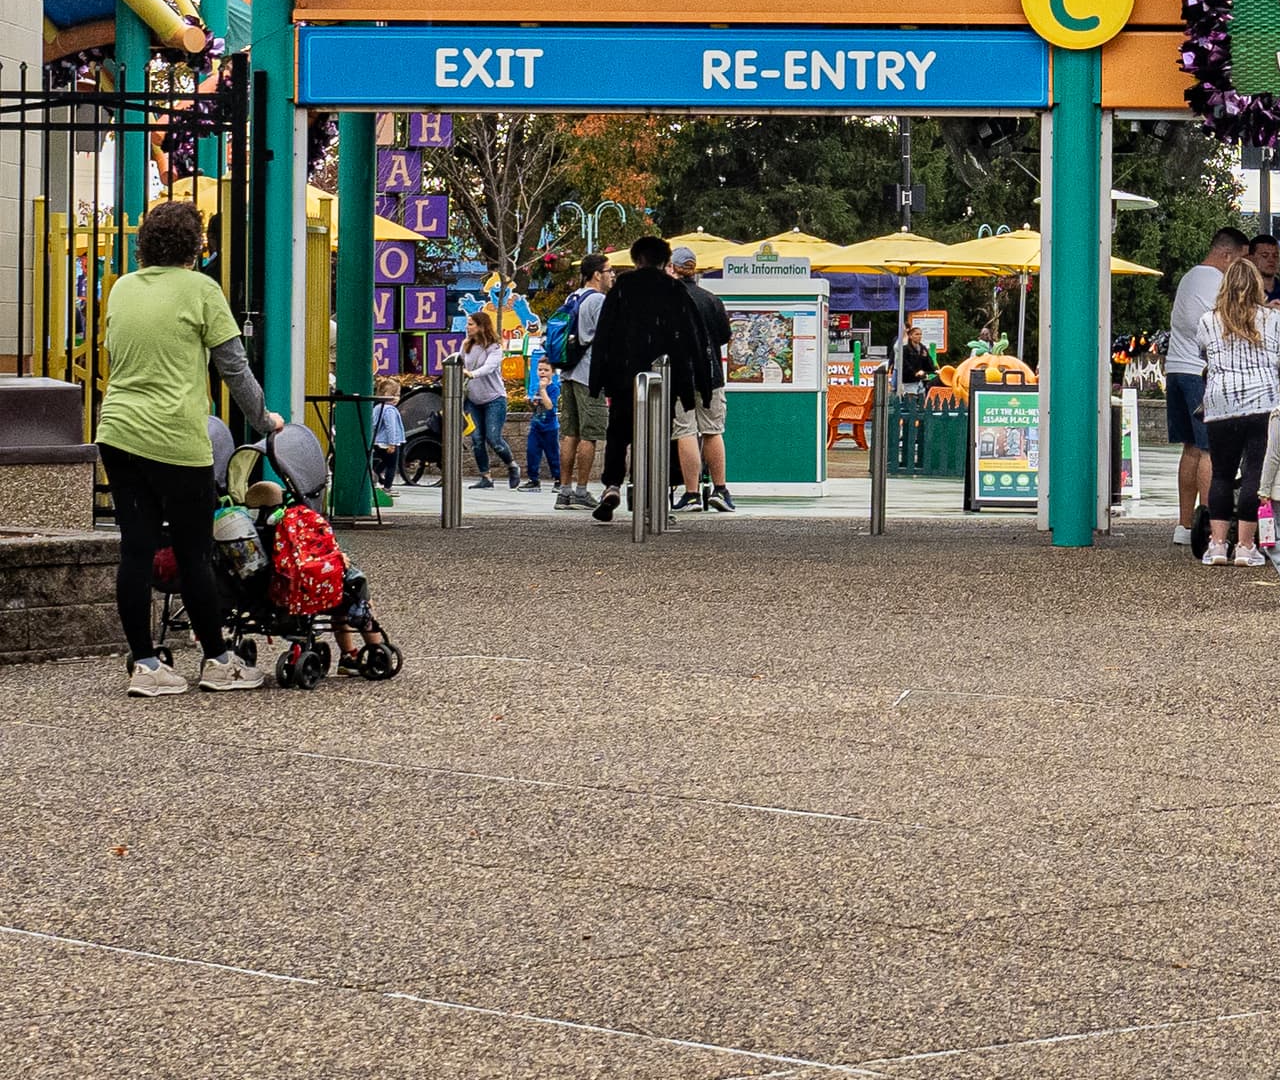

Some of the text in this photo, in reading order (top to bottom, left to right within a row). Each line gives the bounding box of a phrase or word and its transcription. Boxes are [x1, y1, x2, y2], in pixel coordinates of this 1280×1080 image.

[435, 47, 544, 88] EXIT
[702, 49, 937, 90] RE-ENTRY
[728, 263, 807, 275] Park Information
[983, 415, 1009, 424] SESAME
[1010, 415, 1030, 424] PLACE
